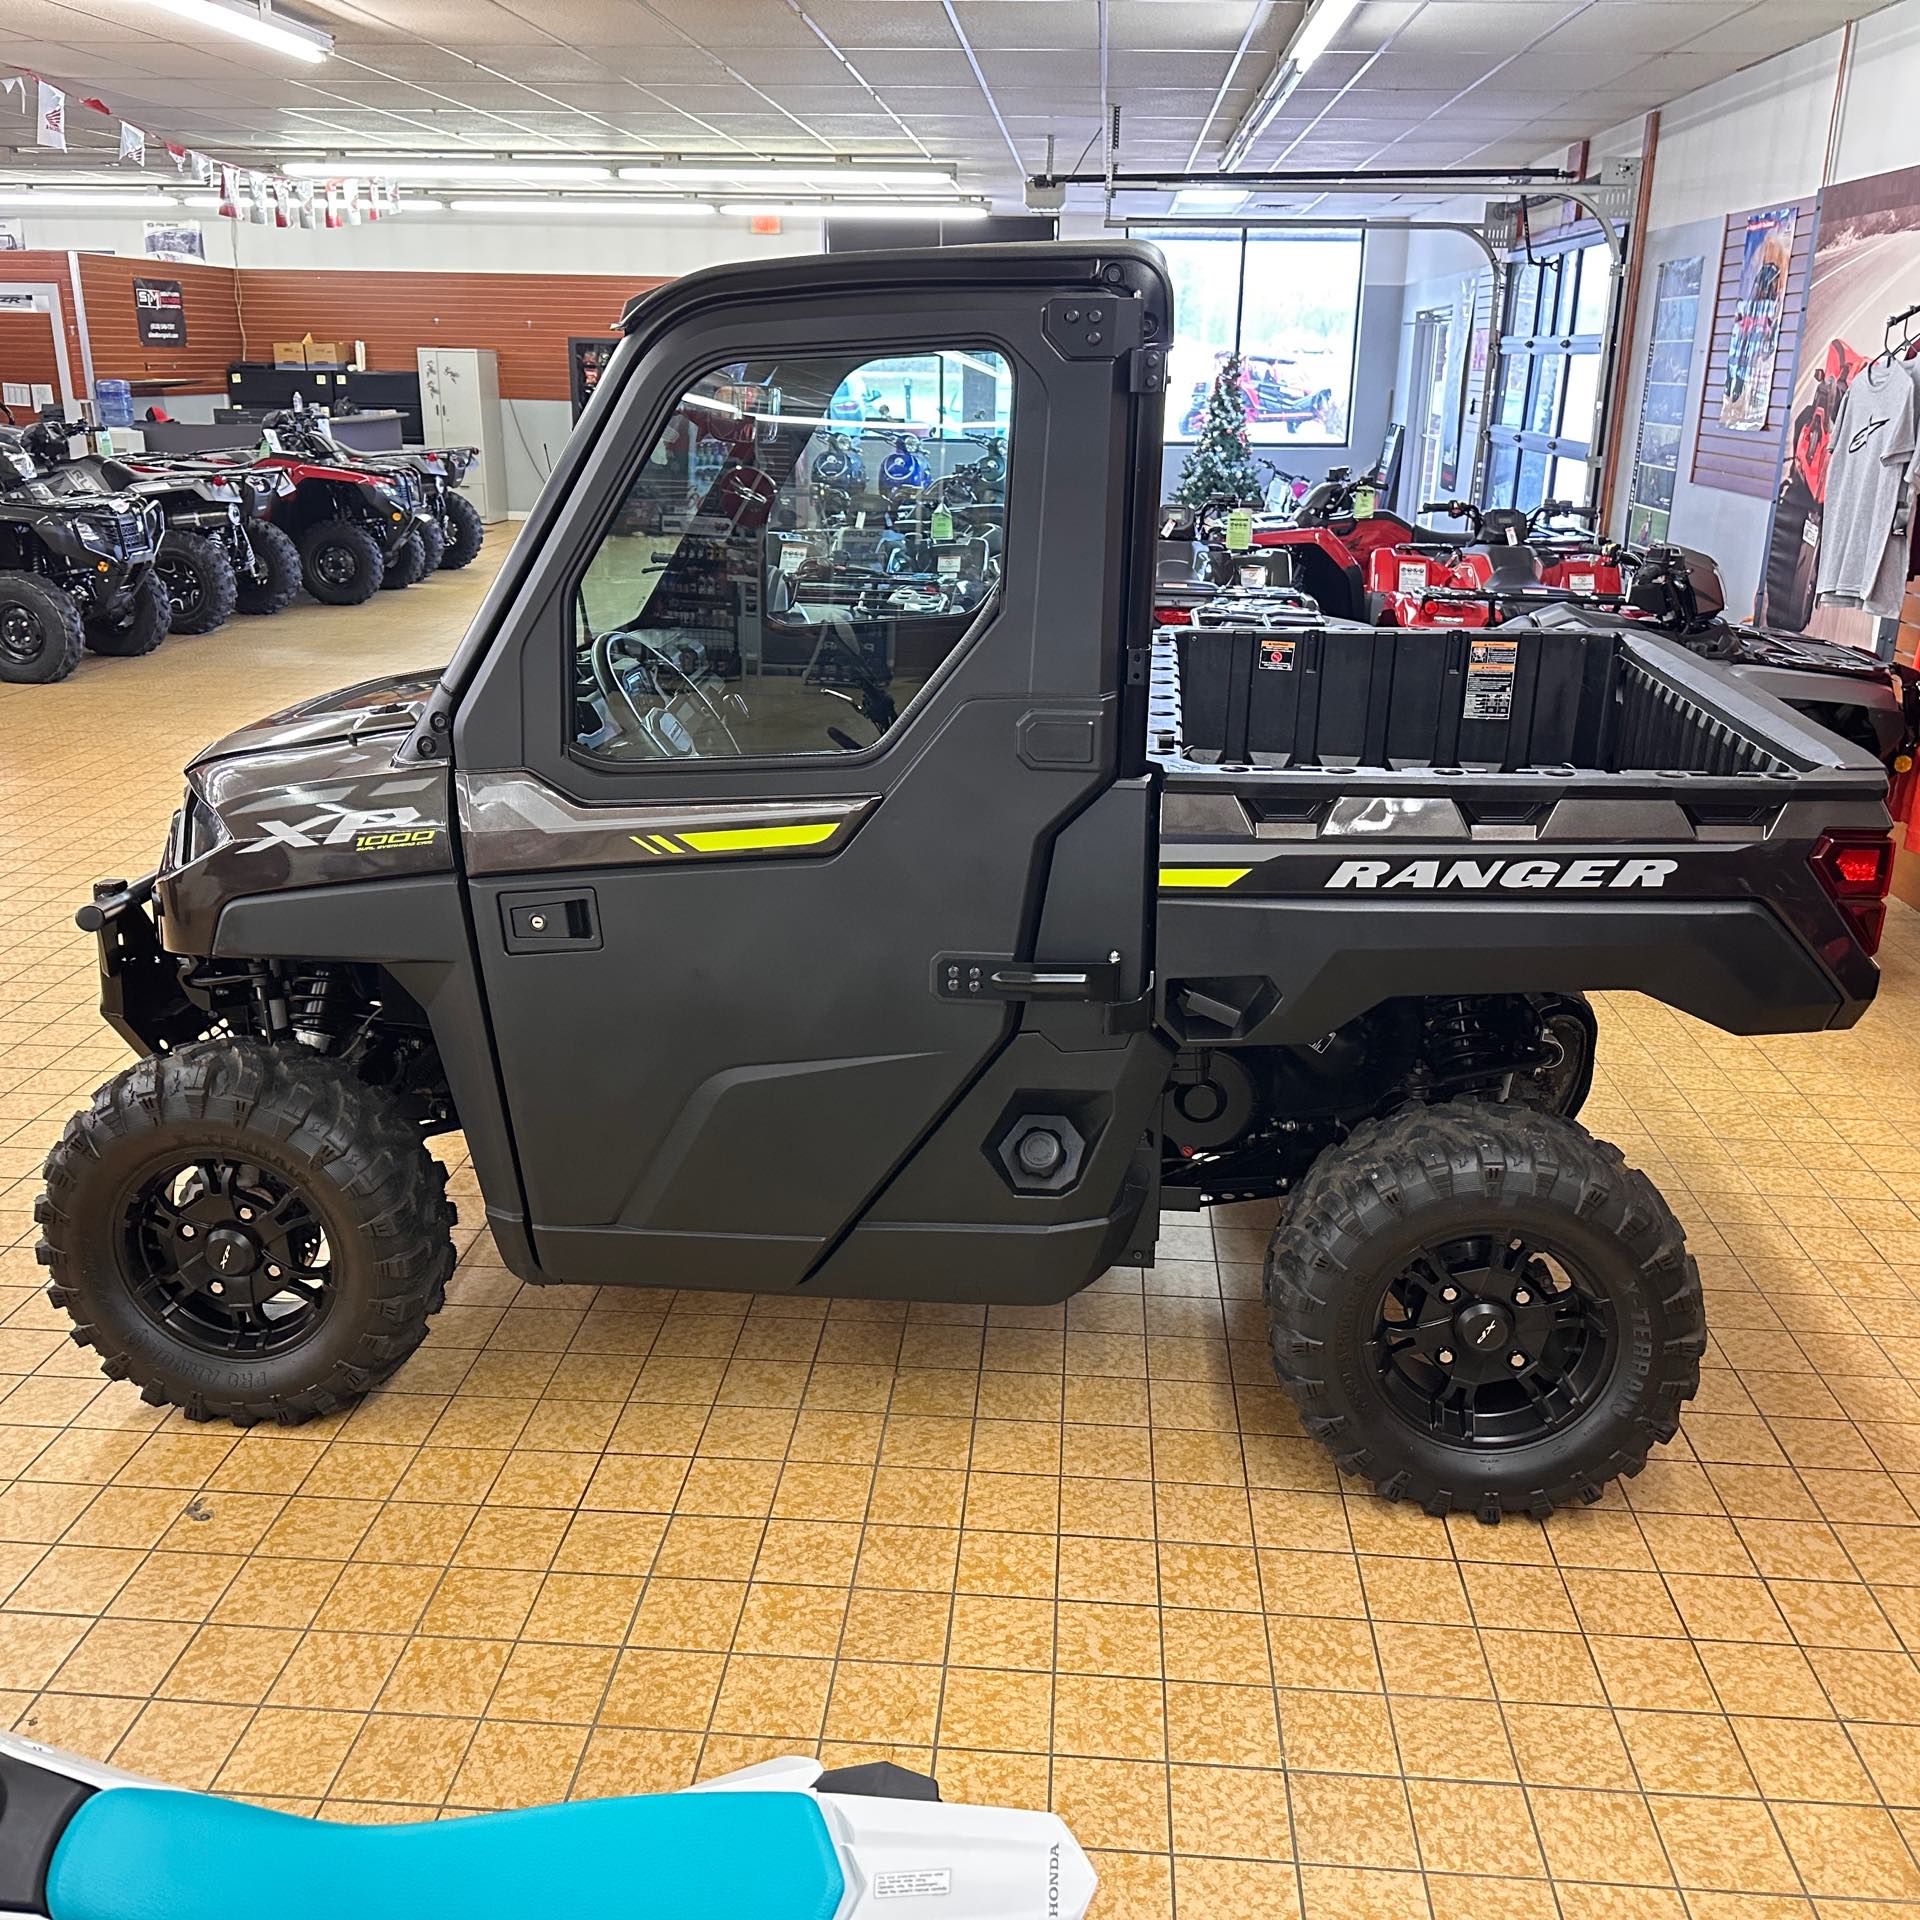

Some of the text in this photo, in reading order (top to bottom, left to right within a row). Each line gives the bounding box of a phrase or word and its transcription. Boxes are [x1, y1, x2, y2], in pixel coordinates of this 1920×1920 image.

[234, 802, 422, 854] XP
[356, 830, 436, 847] 1000
[1324, 859, 1679, 888] RANGER
[1612, 1280, 1652, 1418] X-TERRAIN
[1048, 1842, 1059, 1917] HONDA
